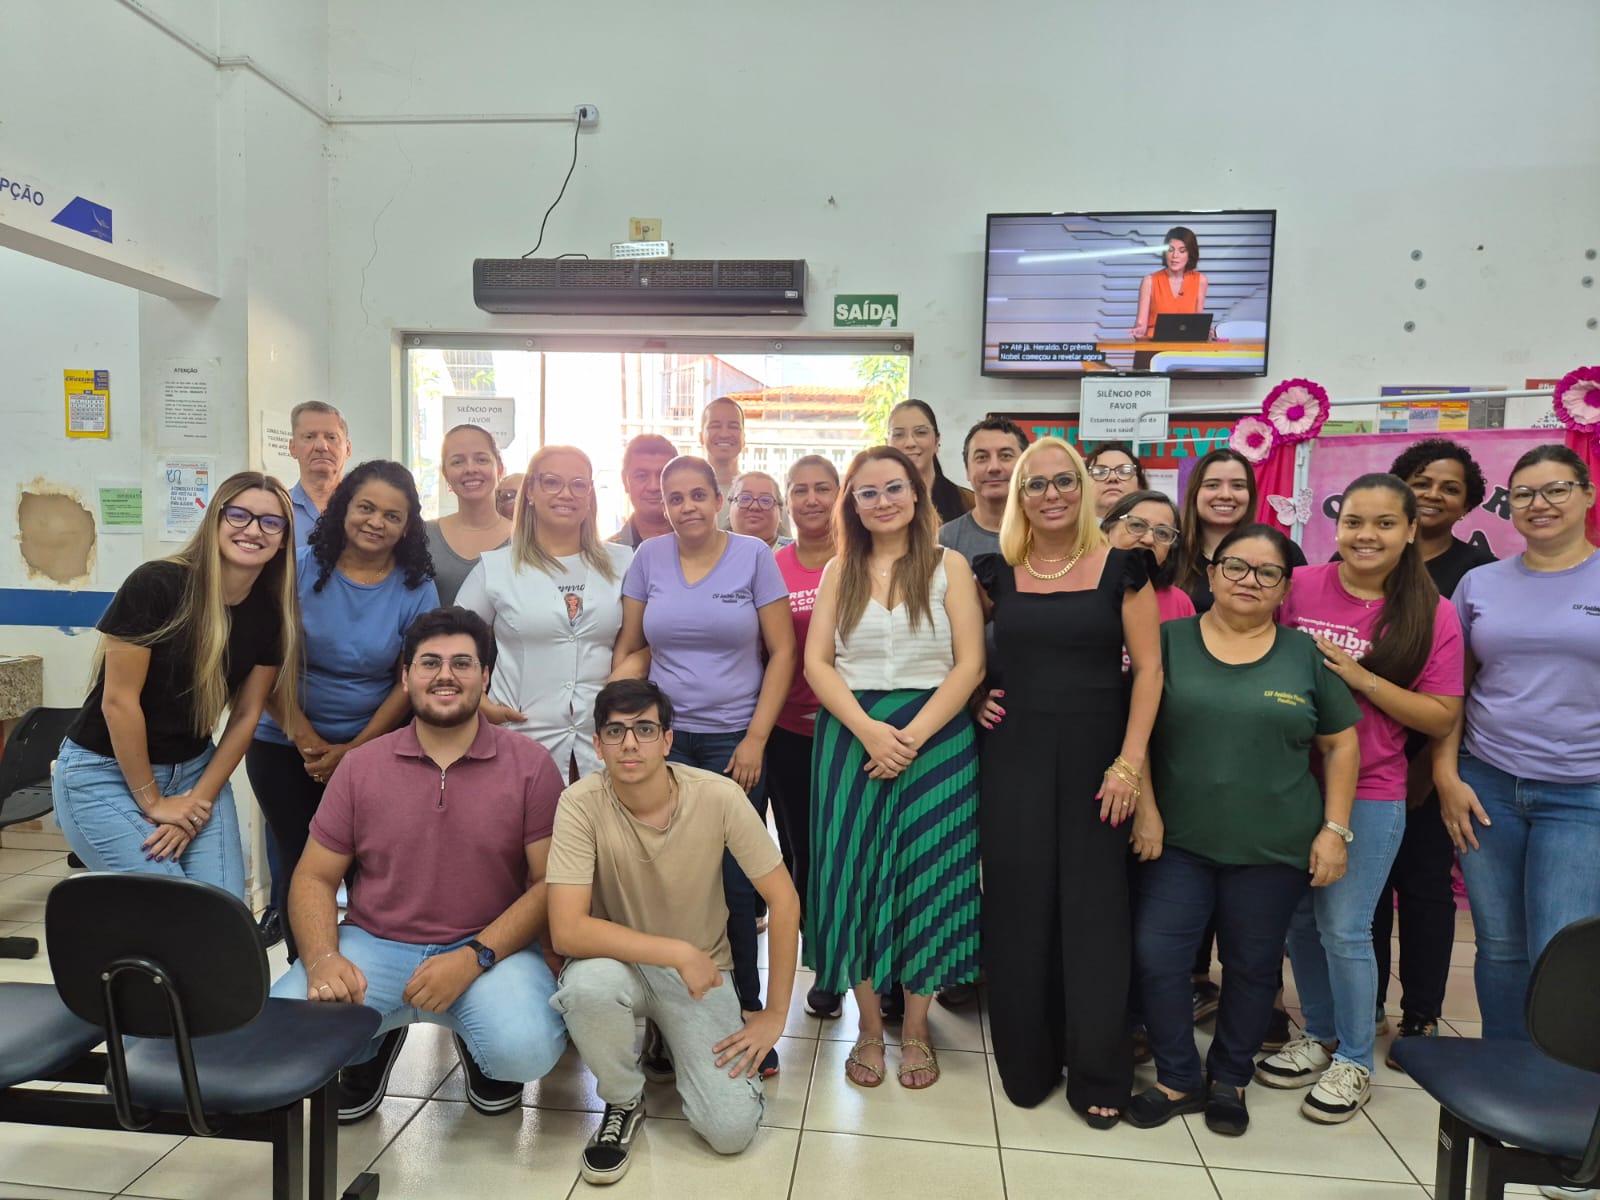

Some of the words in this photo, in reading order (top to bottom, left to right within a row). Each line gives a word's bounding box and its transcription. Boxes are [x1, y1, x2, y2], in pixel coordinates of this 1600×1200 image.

[835, 299, 897, 320] SAÍDA
[1010, 343, 1022, 351] Até
[1069, 343, 1093, 352] prêmio
[1021, 353, 1051, 361] começou
[1097, 389, 1133, 398] SILÊNCIO
[457, 405, 487, 413] SILÊNCIO
